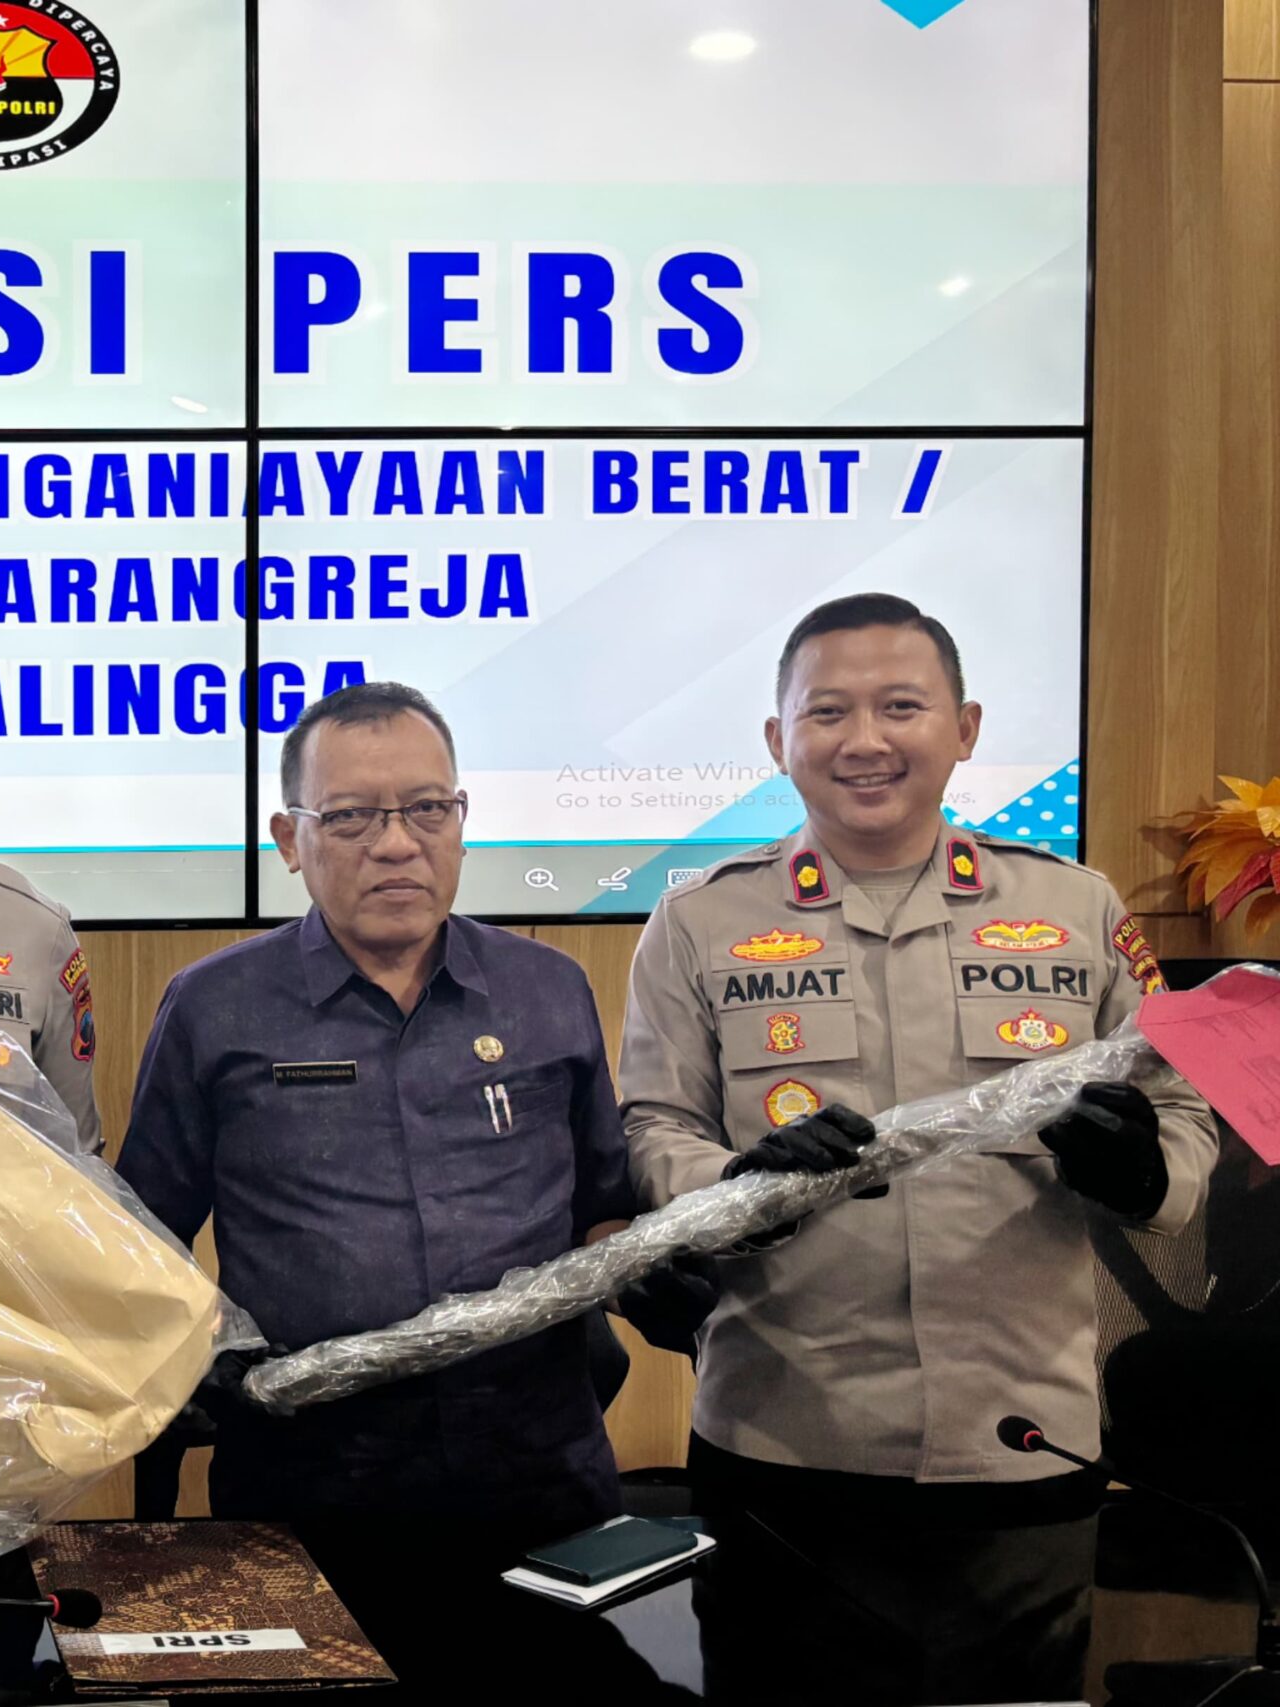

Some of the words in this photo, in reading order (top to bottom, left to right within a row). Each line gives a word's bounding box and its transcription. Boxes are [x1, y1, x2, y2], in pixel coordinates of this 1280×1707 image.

[28, 0, 114, 91] DIPERCAYA
[273, 251, 744, 375] PERS
[591, 449, 860, 514] BERAT
[901, 449, 943, 514] /
[556, 761, 684, 782] Activate
[556, 793, 589, 808] Go
[600, 793, 622, 808] to
[631, 792, 721, 810] Settings
[734, 792, 758, 807] to
[722, 968, 846, 1005] AMJAT
[961, 964, 1088, 997] POLRI
[152, 1633, 252, 1648] SPRI
